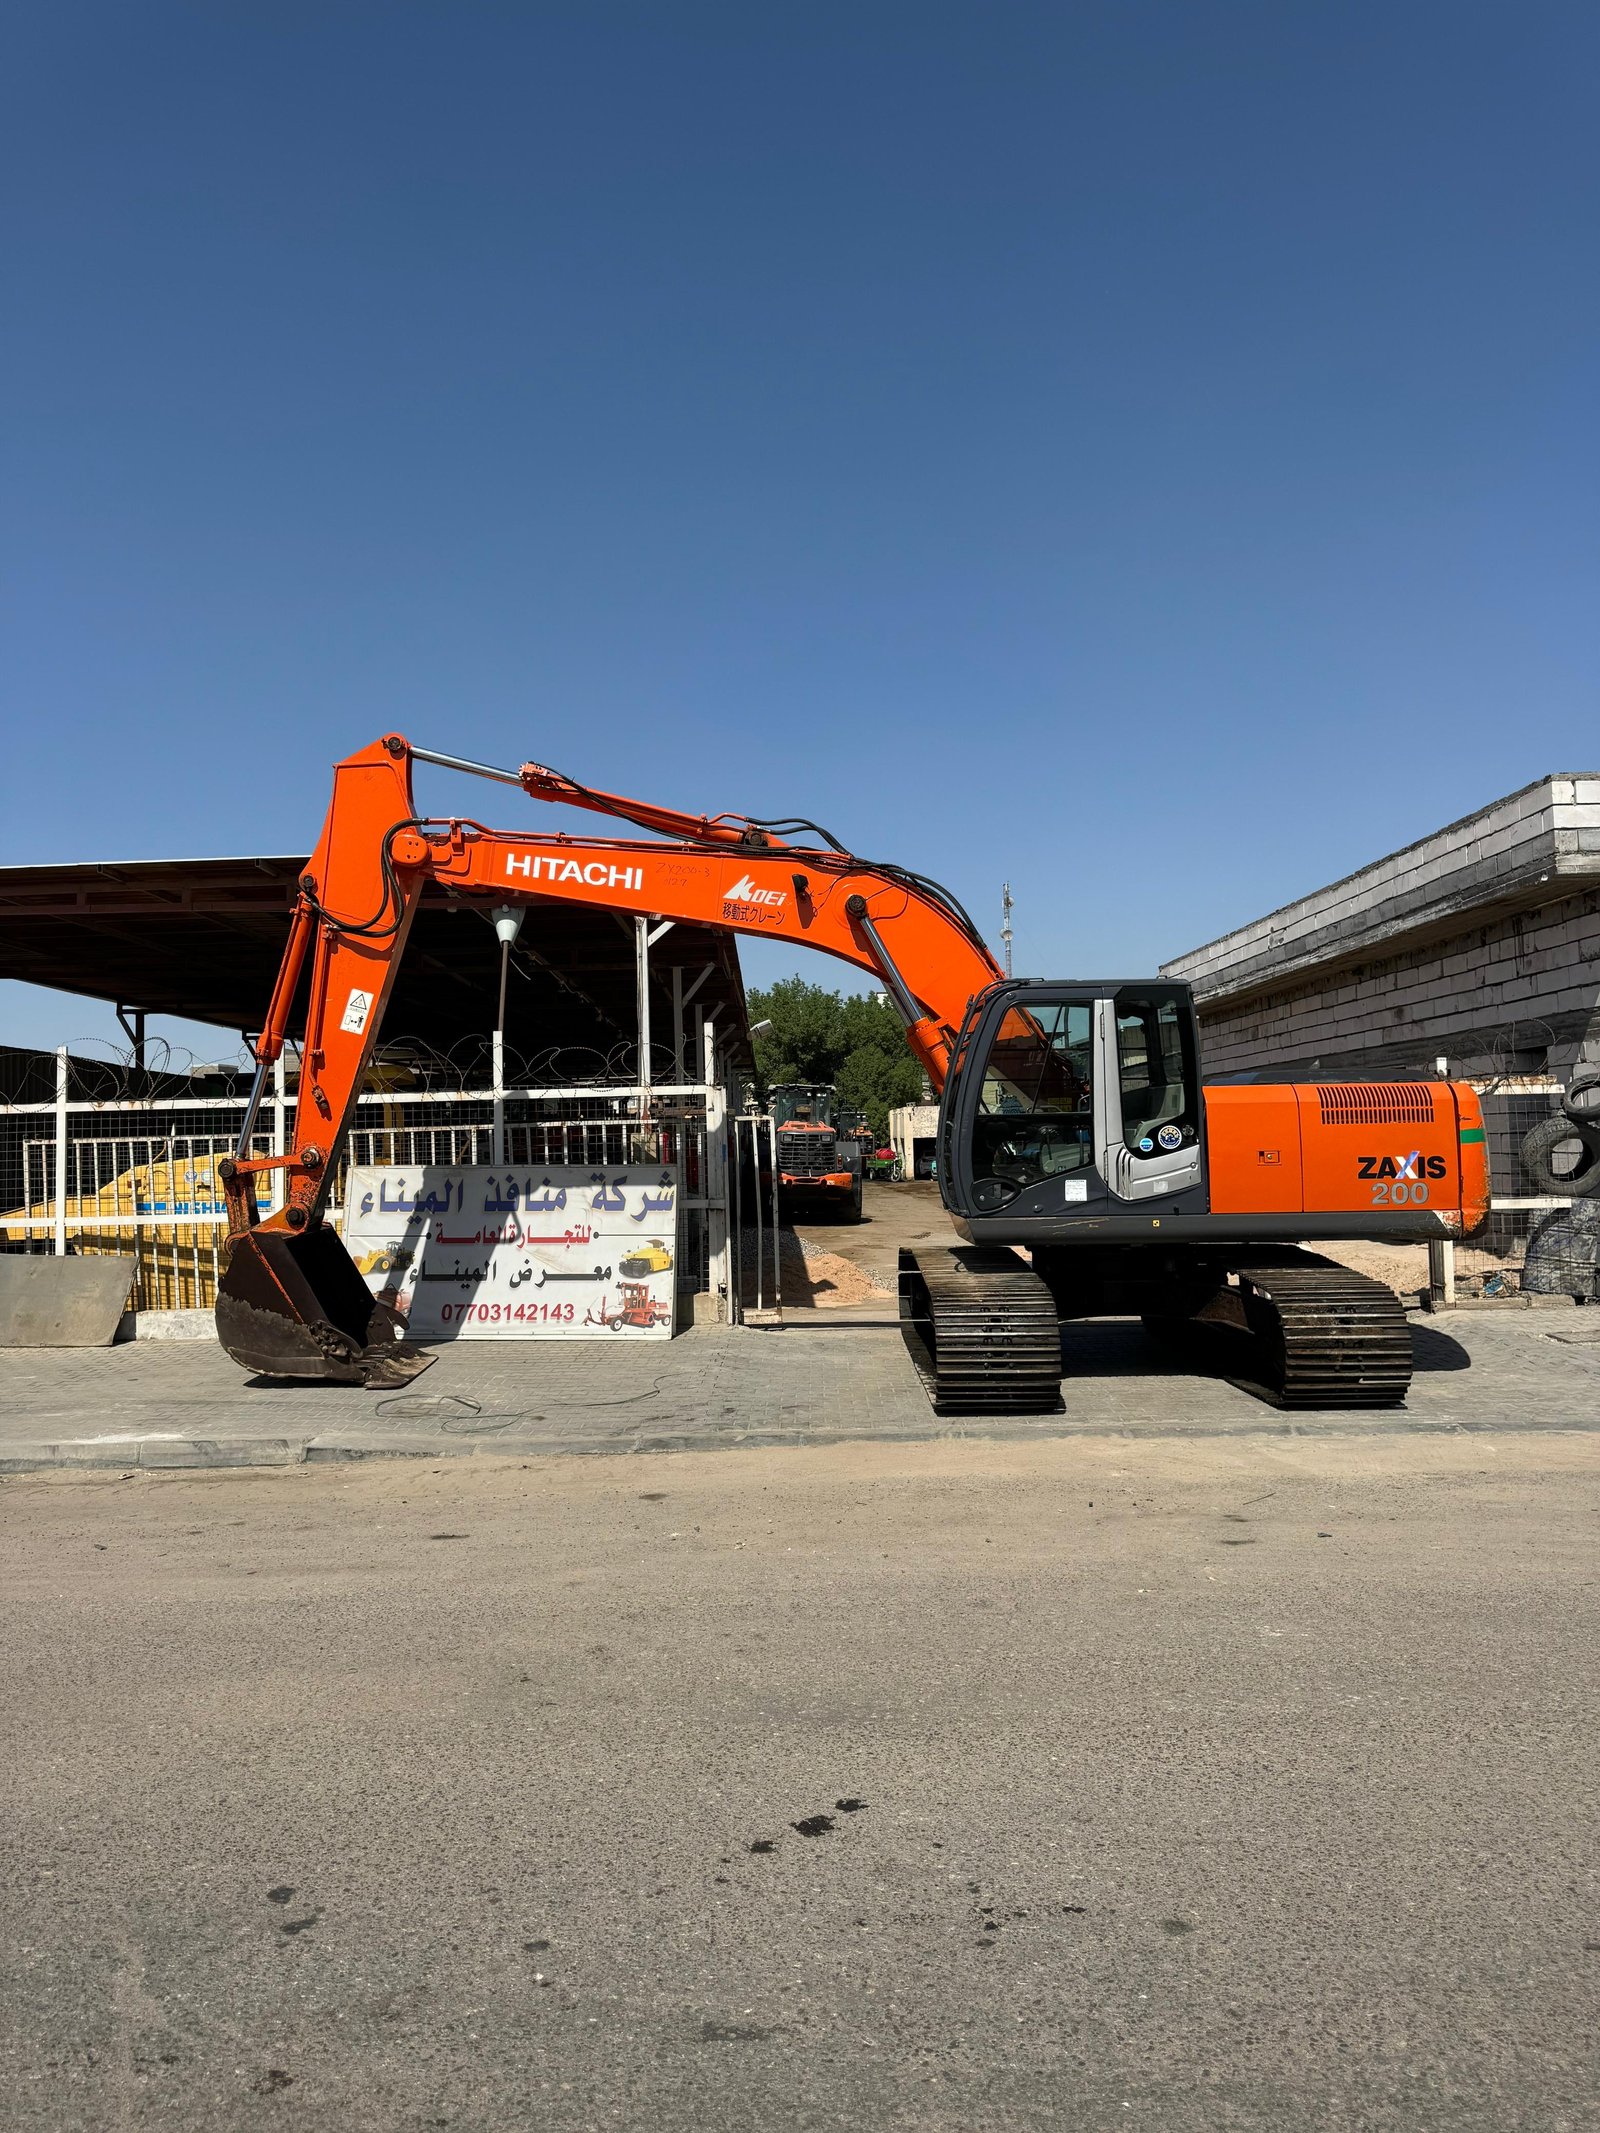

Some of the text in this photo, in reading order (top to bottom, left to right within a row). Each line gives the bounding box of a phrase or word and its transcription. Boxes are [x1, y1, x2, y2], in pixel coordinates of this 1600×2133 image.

[506, 853, 643, 891] HITACHI
[723, 902, 786, 926] 移動式クレーン
[1357, 1150, 1447, 1180] ZAXIS
[360, 1170, 675, 1225] شركة منافذ الميناء
[1371, 1182, 1430, 1205] 200
[441, 1303, 575, 1323] 07703142143
